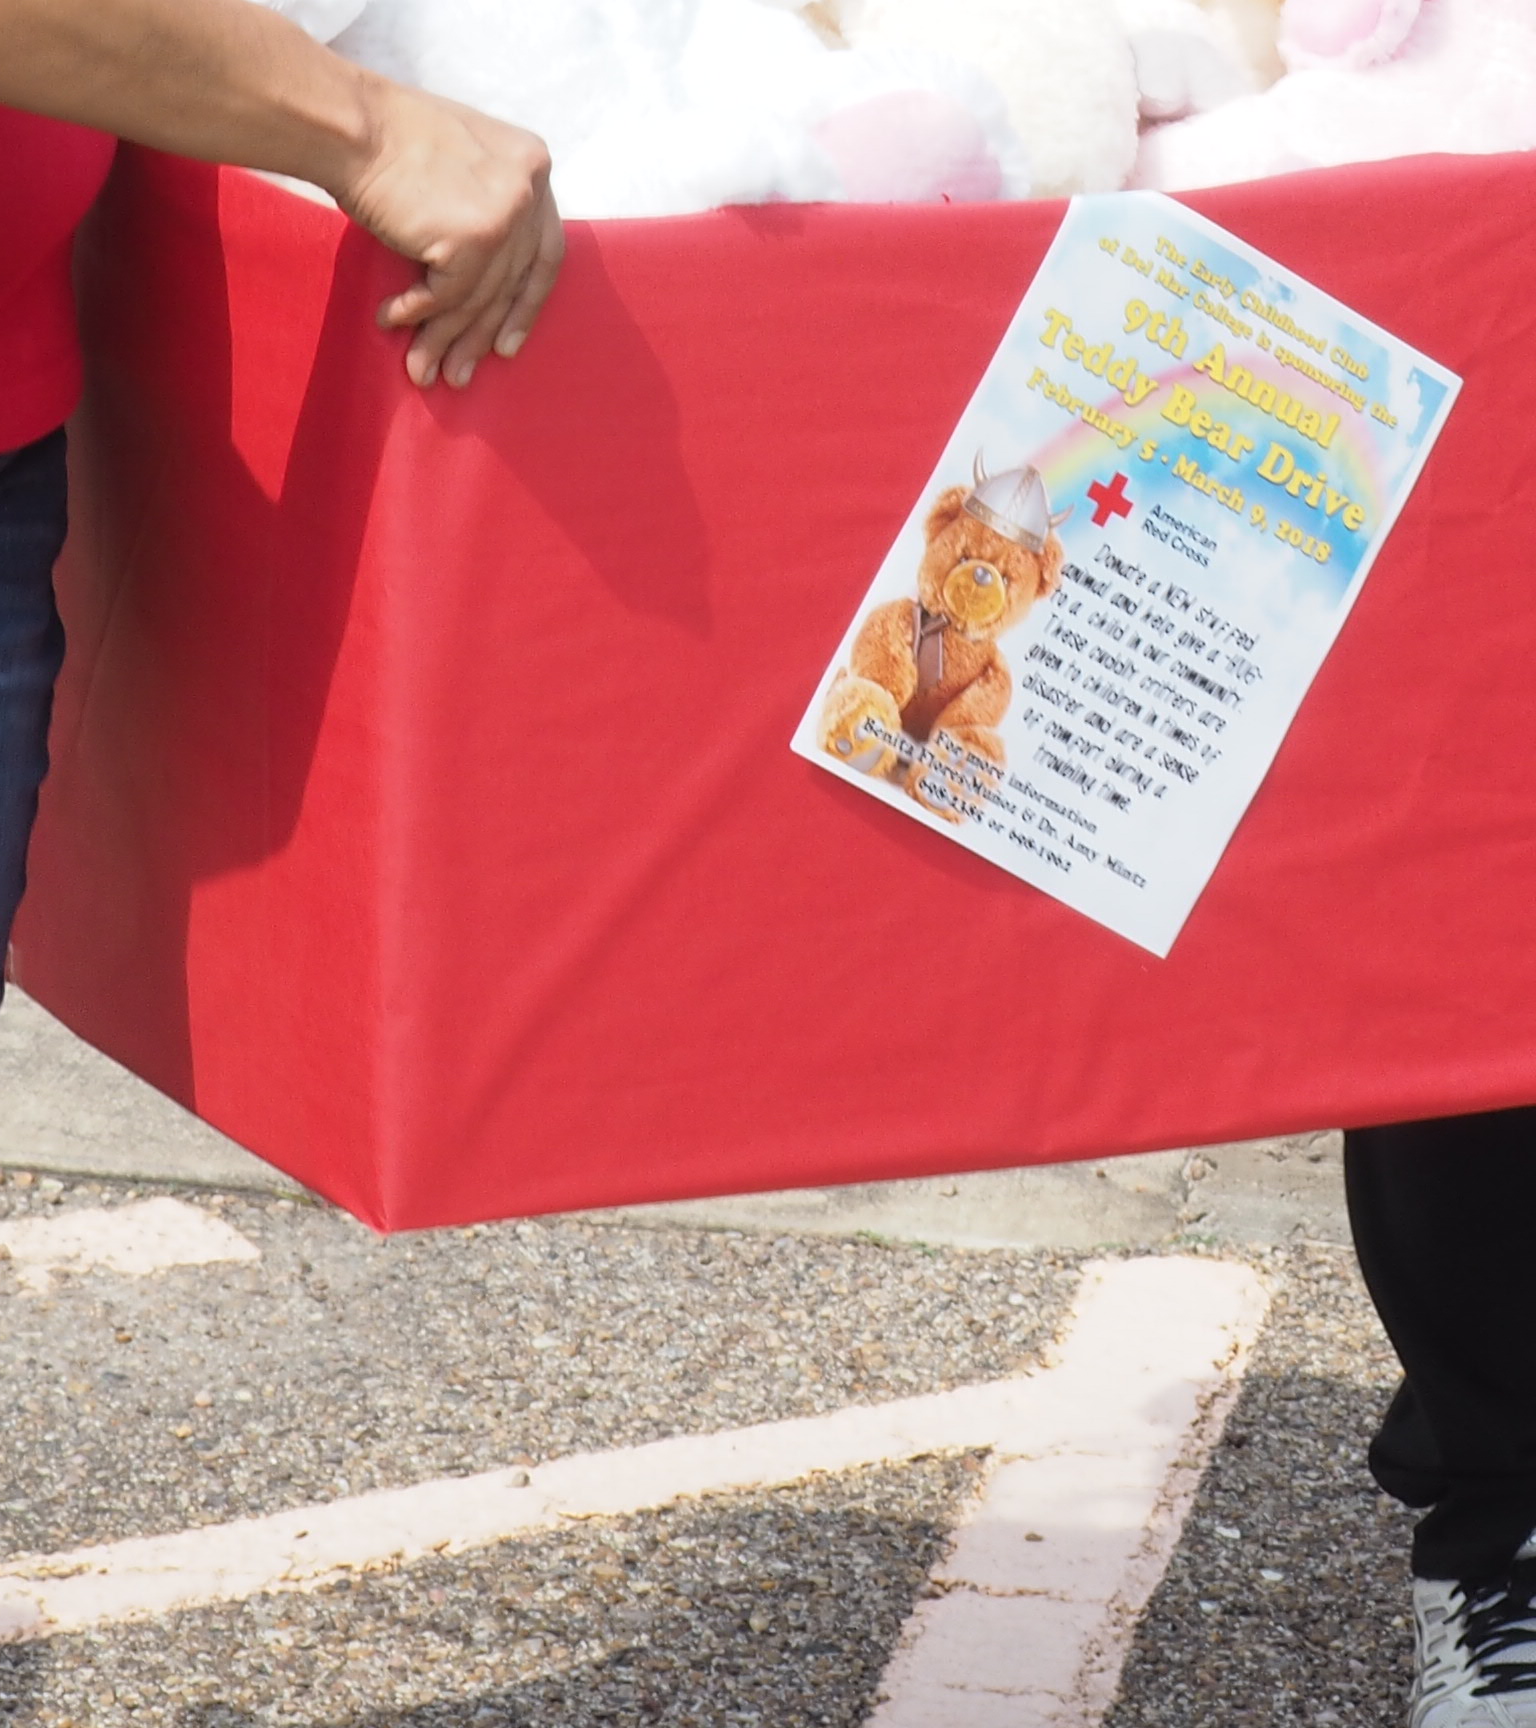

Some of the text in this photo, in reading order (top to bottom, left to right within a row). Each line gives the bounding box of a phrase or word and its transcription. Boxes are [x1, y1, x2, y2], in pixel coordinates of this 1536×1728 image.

[1098, 237, 1120, 254] of
[1122, 247, 1154, 276] Del
[1155, 268, 1190, 297] Mar
[1193, 291, 1254, 338] College
[1274, 346, 1367, 412] sponsoring
[1370, 402, 1398, 426] the
[1190, 258, 1238, 300] Early
[1240, 290, 1329, 354] Childhood
[1329, 346, 1370, 380] Club
[1040, 308, 1369, 531] Teddy Bear Drive
[1123, 298, 1343, 450] 9th Annual
[1027, 367, 1142, 450] February
[1140, 438, 1159, 461] 5
[1172, 454, 1247, 514] March
[1248, 503, 1272, 532] 9,
[1275, 520, 1332, 564] 2018
[1141, 518, 1211, 567] Red Cross
[1150, 503, 1219, 553] American
[1068, 602, 1082, 616] a
[1086, 608, 1128, 642] child
[1093, 543, 1260, 653] Donate a NEW stuffed
[1110, 588, 1142, 618] and
[1139, 606, 1177, 638] help
[1172, 630, 1207, 656] give
[1206, 650, 1220, 664] a
[1022, 674, 1086, 716] disaster
[1083, 707, 1115, 736] and
[1114, 729, 1144, 752] are
[1143, 744, 1158, 761] a
[1051, 613, 1090, 654] These
[1138, 675, 1199, 718] critters
[1197, 711, 1227, 734] are
[1066, 660, 1084, 682] to
[1082, 676, 1144, 719] children
[934, 730, 965, 756] For
[1008, 774, 1099, 834] information
[1152, 783, 1168, 800] a
